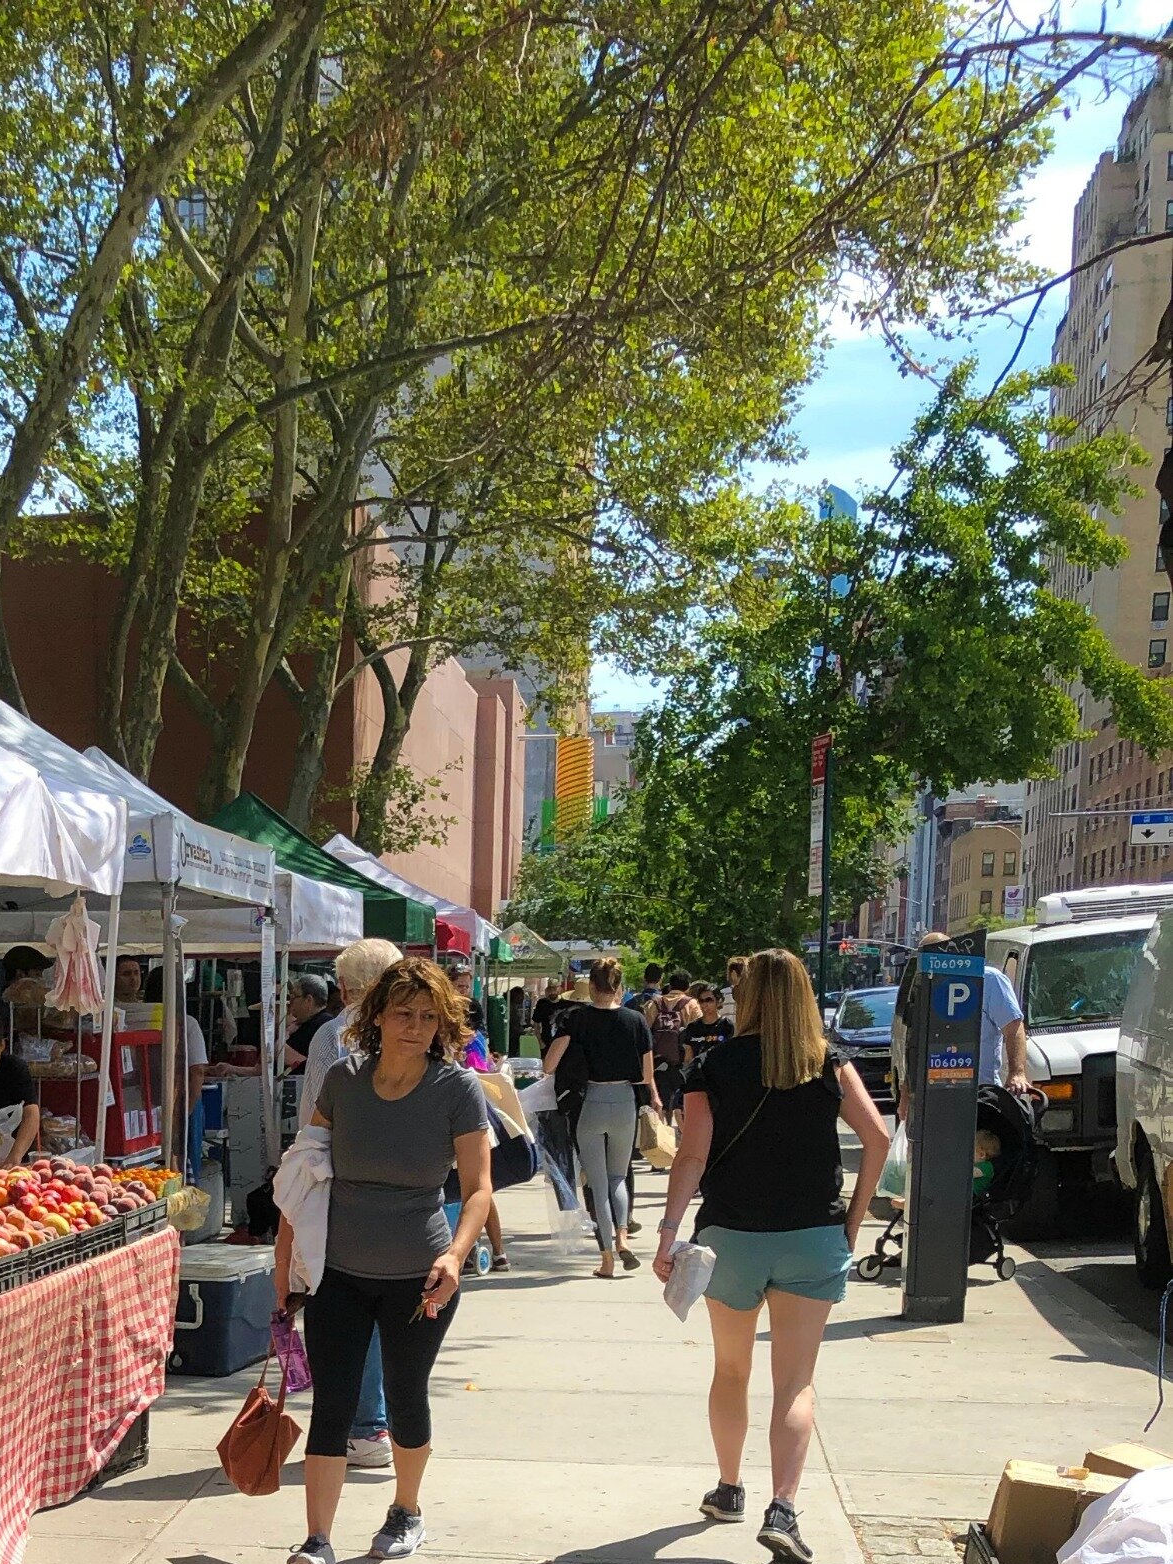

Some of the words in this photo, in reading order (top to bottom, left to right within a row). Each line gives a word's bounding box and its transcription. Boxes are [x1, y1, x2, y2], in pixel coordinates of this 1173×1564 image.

[930, 959, 971, 969] 106099
[947, 983, 970, 1016] P
[930, 1057, 972, 1068] 106099
